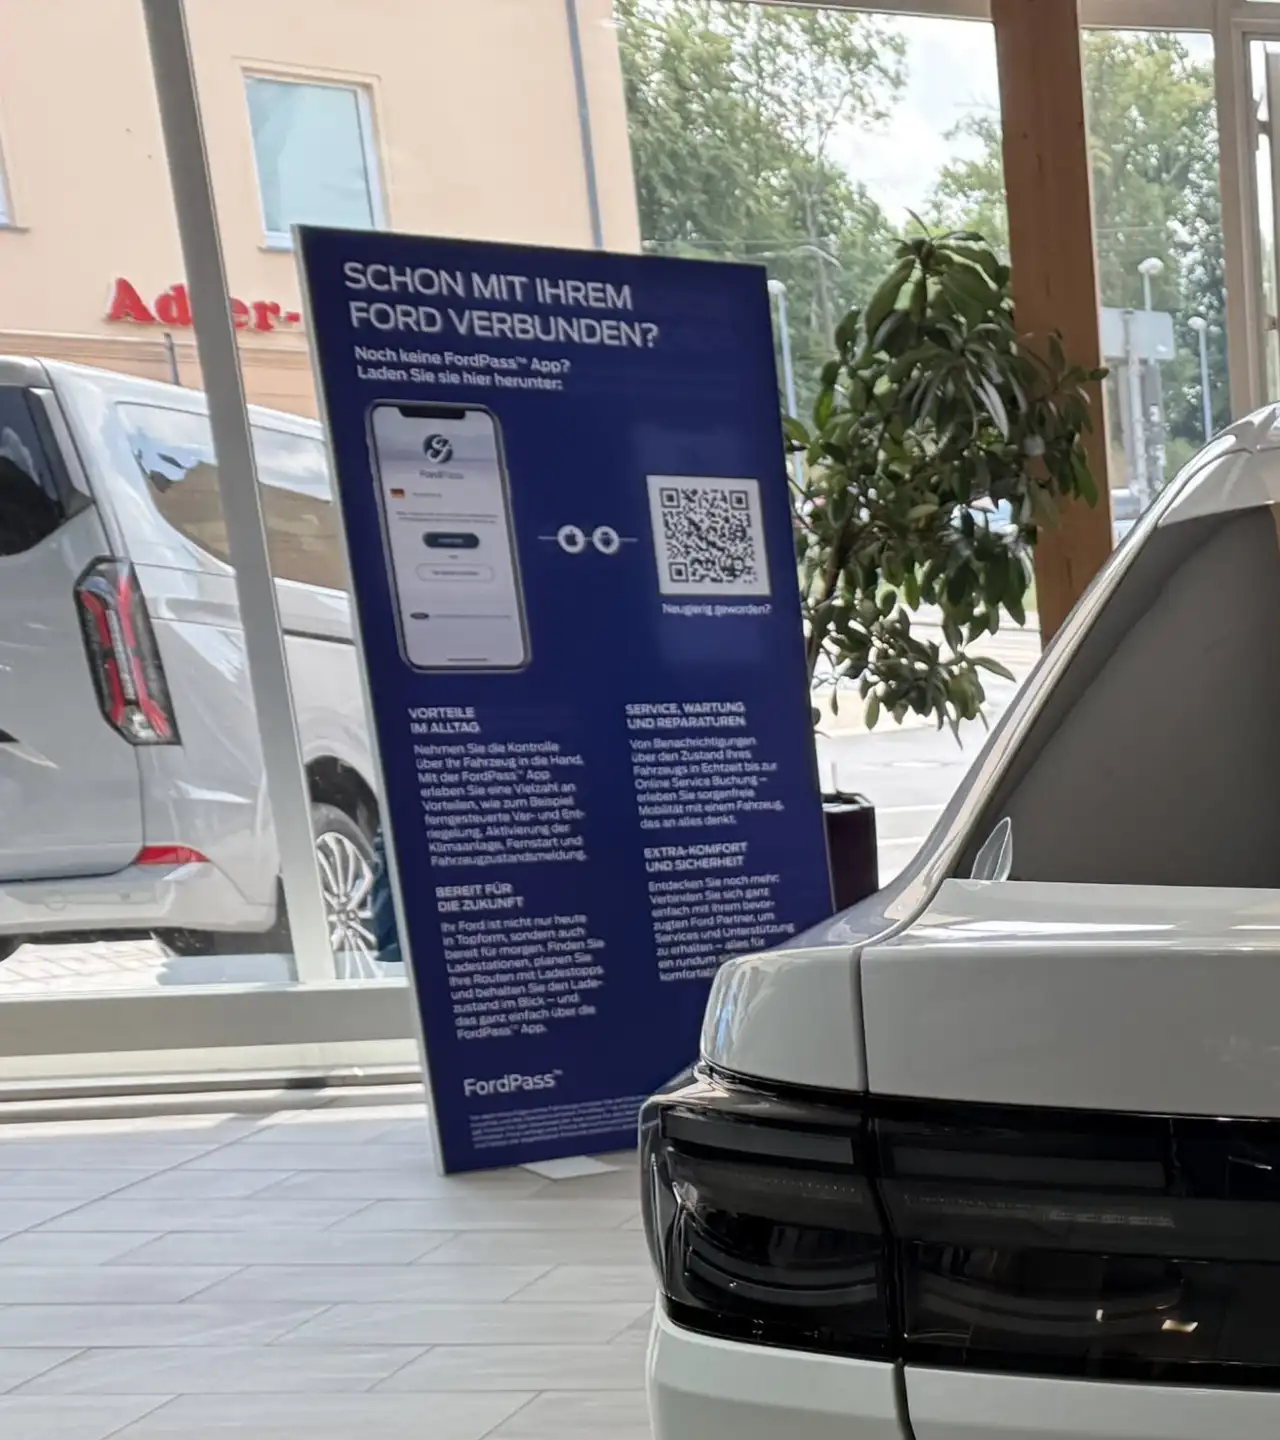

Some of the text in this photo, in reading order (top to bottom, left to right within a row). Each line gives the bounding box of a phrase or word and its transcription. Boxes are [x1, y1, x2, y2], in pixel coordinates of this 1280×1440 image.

[343, 262, 633, 310] SCHON MIT IHREM
[348, 301, 658, 348] FORD VERBUNDEN?
[354, 345, 397, 363] Noch
[399, 348, 442, 365] keine
[530, 357, 572, 373] App?
[357, 365, 563, 390] Laden Sie sie hier herunter:
[408, 707, 475, 718] VORTEILE
[625, 702, 744, 714] SERVICE, WARTUNG
[411, 722, 480, 733] IM ALLTAG
[627, 716, 746, 728] UND REPARATUREN
[644, 842, 747, 858] EXTRA-KOMFORT
[646, 856, 744, 872] UND SICHERHEIT
[436, 882, 511, 897] BEREIT FÜR
[438, 897, 523, 911] DIE ZUKUNFT
